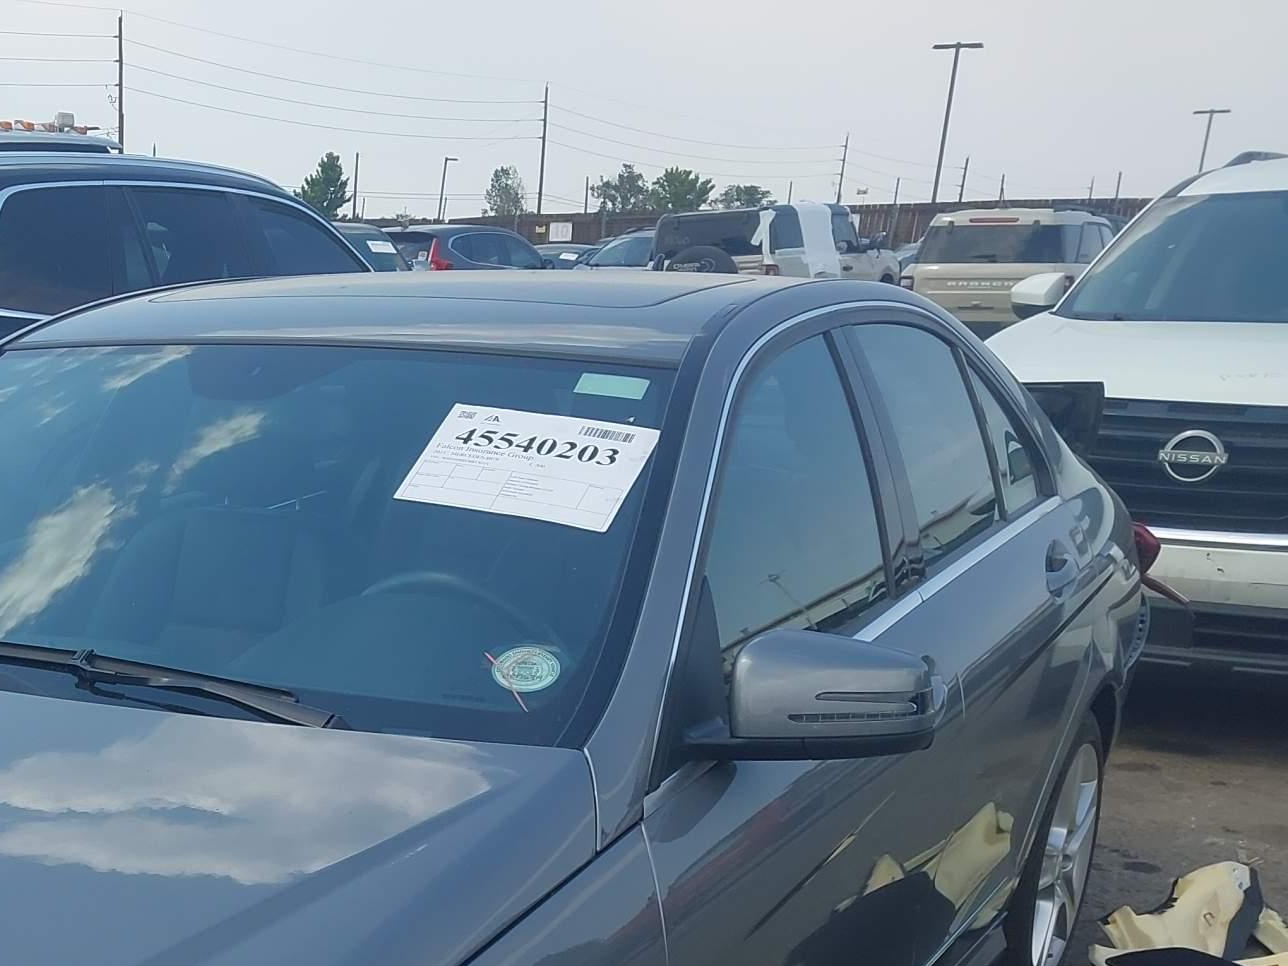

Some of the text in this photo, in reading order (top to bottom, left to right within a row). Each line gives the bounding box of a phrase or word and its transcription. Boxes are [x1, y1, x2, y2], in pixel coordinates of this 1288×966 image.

[455, 427, 620, 467] 45540203
[465, 445, 506, 456] Insurance
[507, 452, 535, 461] Group
[1159, 452, 1226, 464] NISSAN
